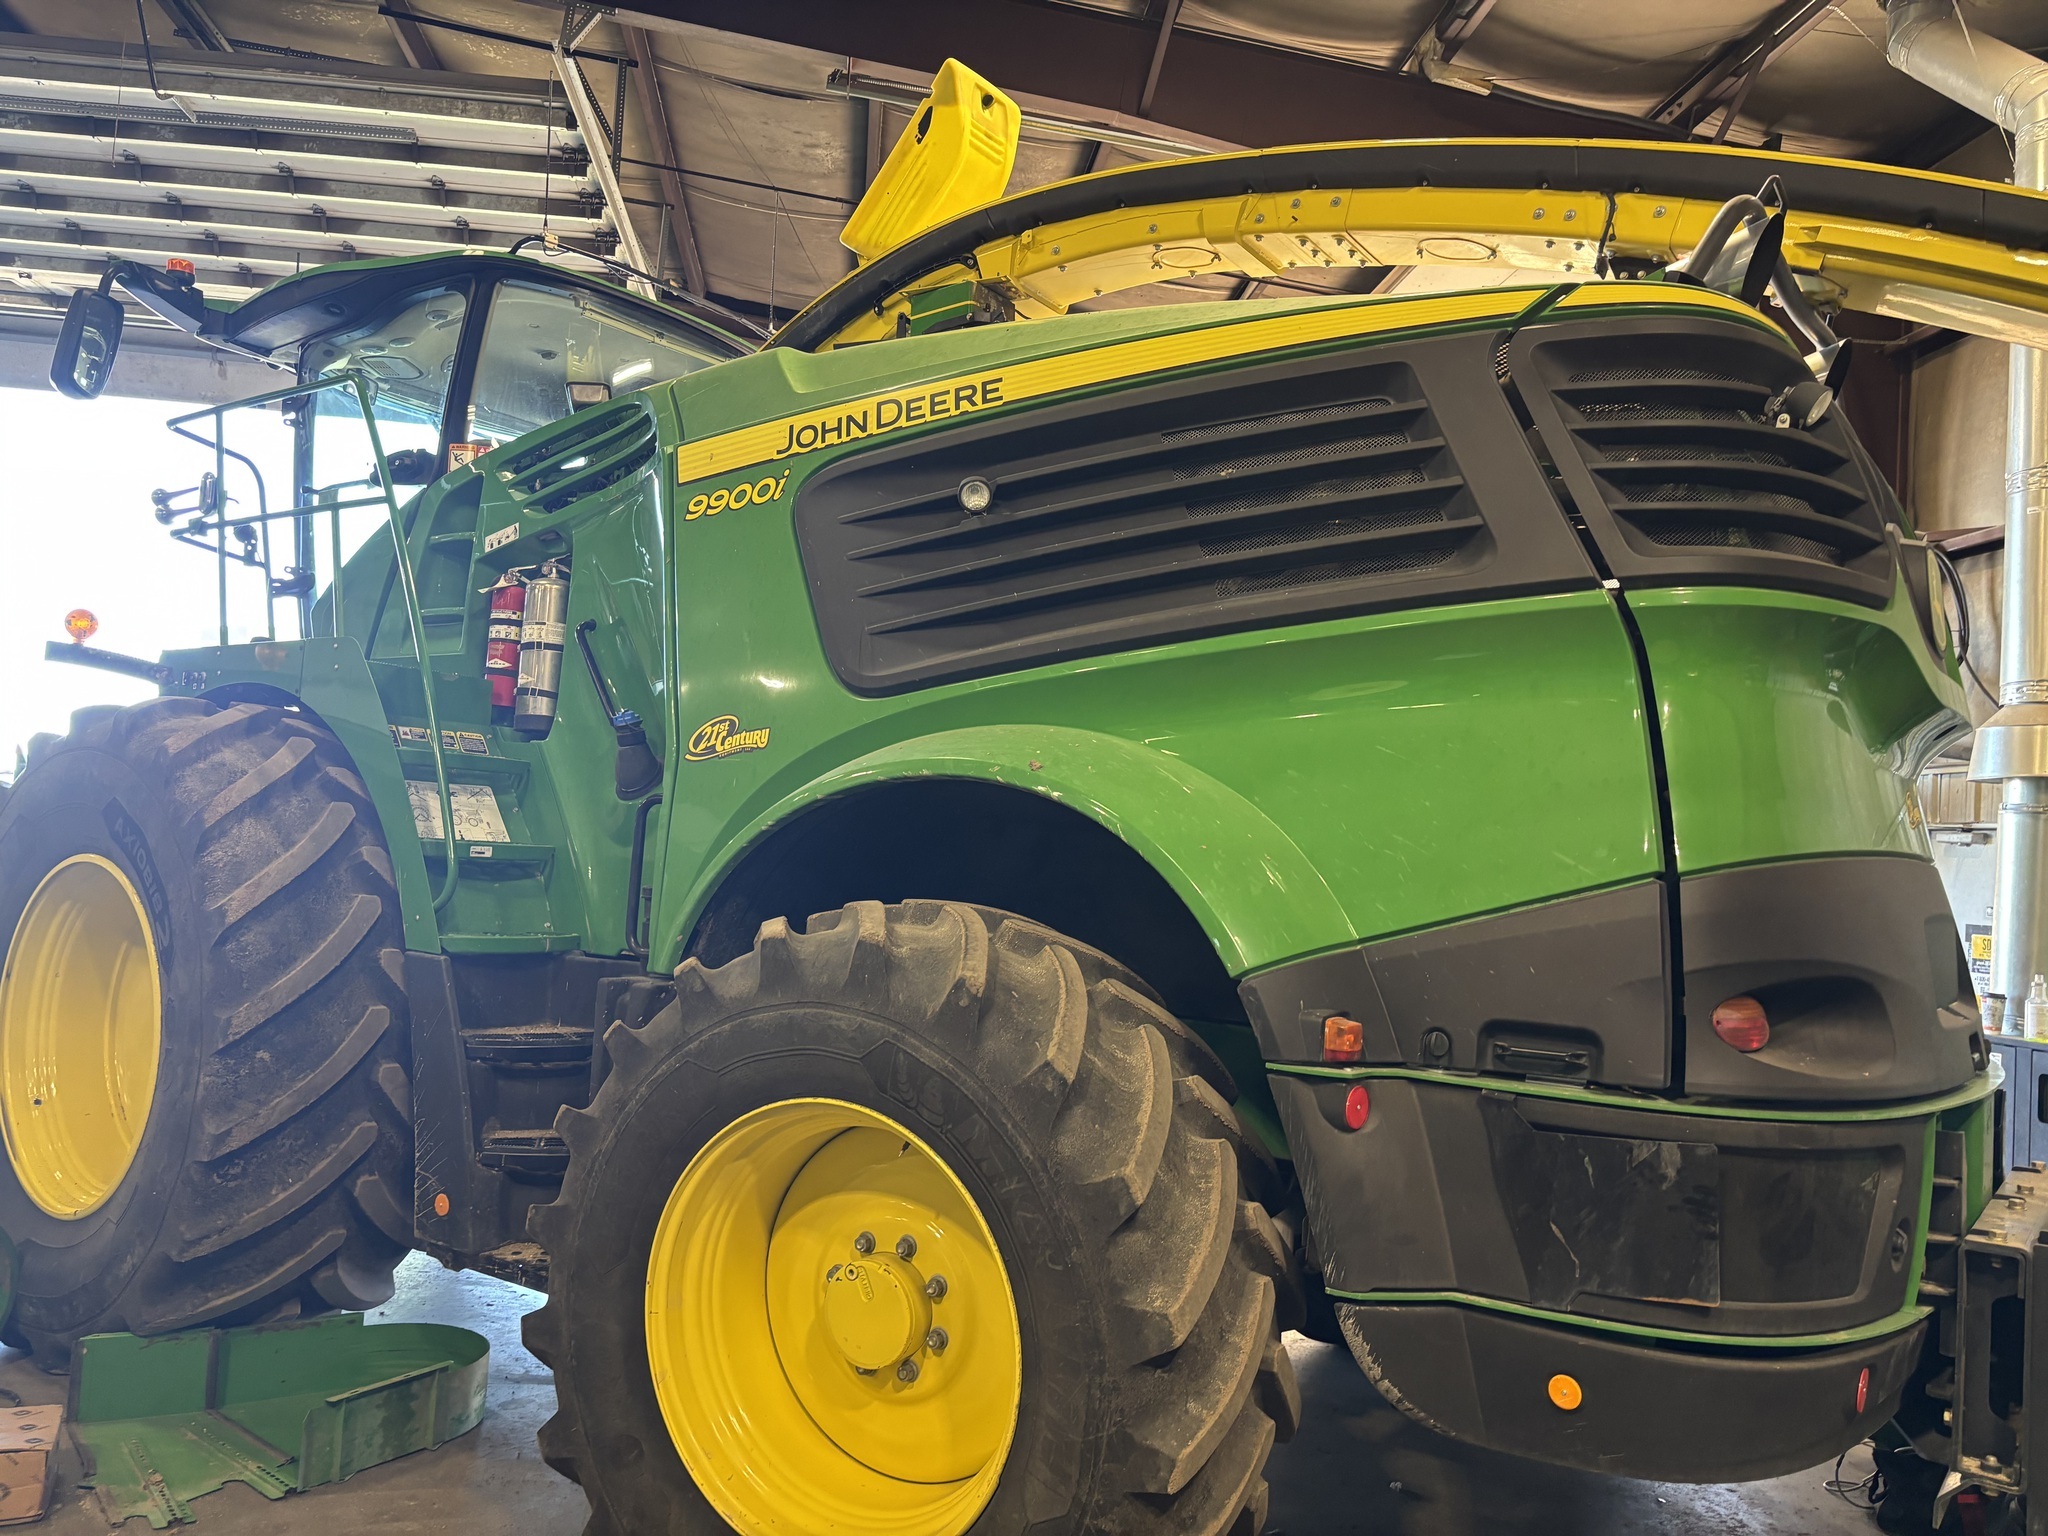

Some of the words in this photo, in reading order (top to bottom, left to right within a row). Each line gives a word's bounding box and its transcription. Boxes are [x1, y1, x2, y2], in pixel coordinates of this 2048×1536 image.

[776, 410, 868, 455] JOHN
[876, 377, 1004, 429] DEERE
[684, 468, 791, 521] 9900i
[696, 720, 730, 752] 21st
